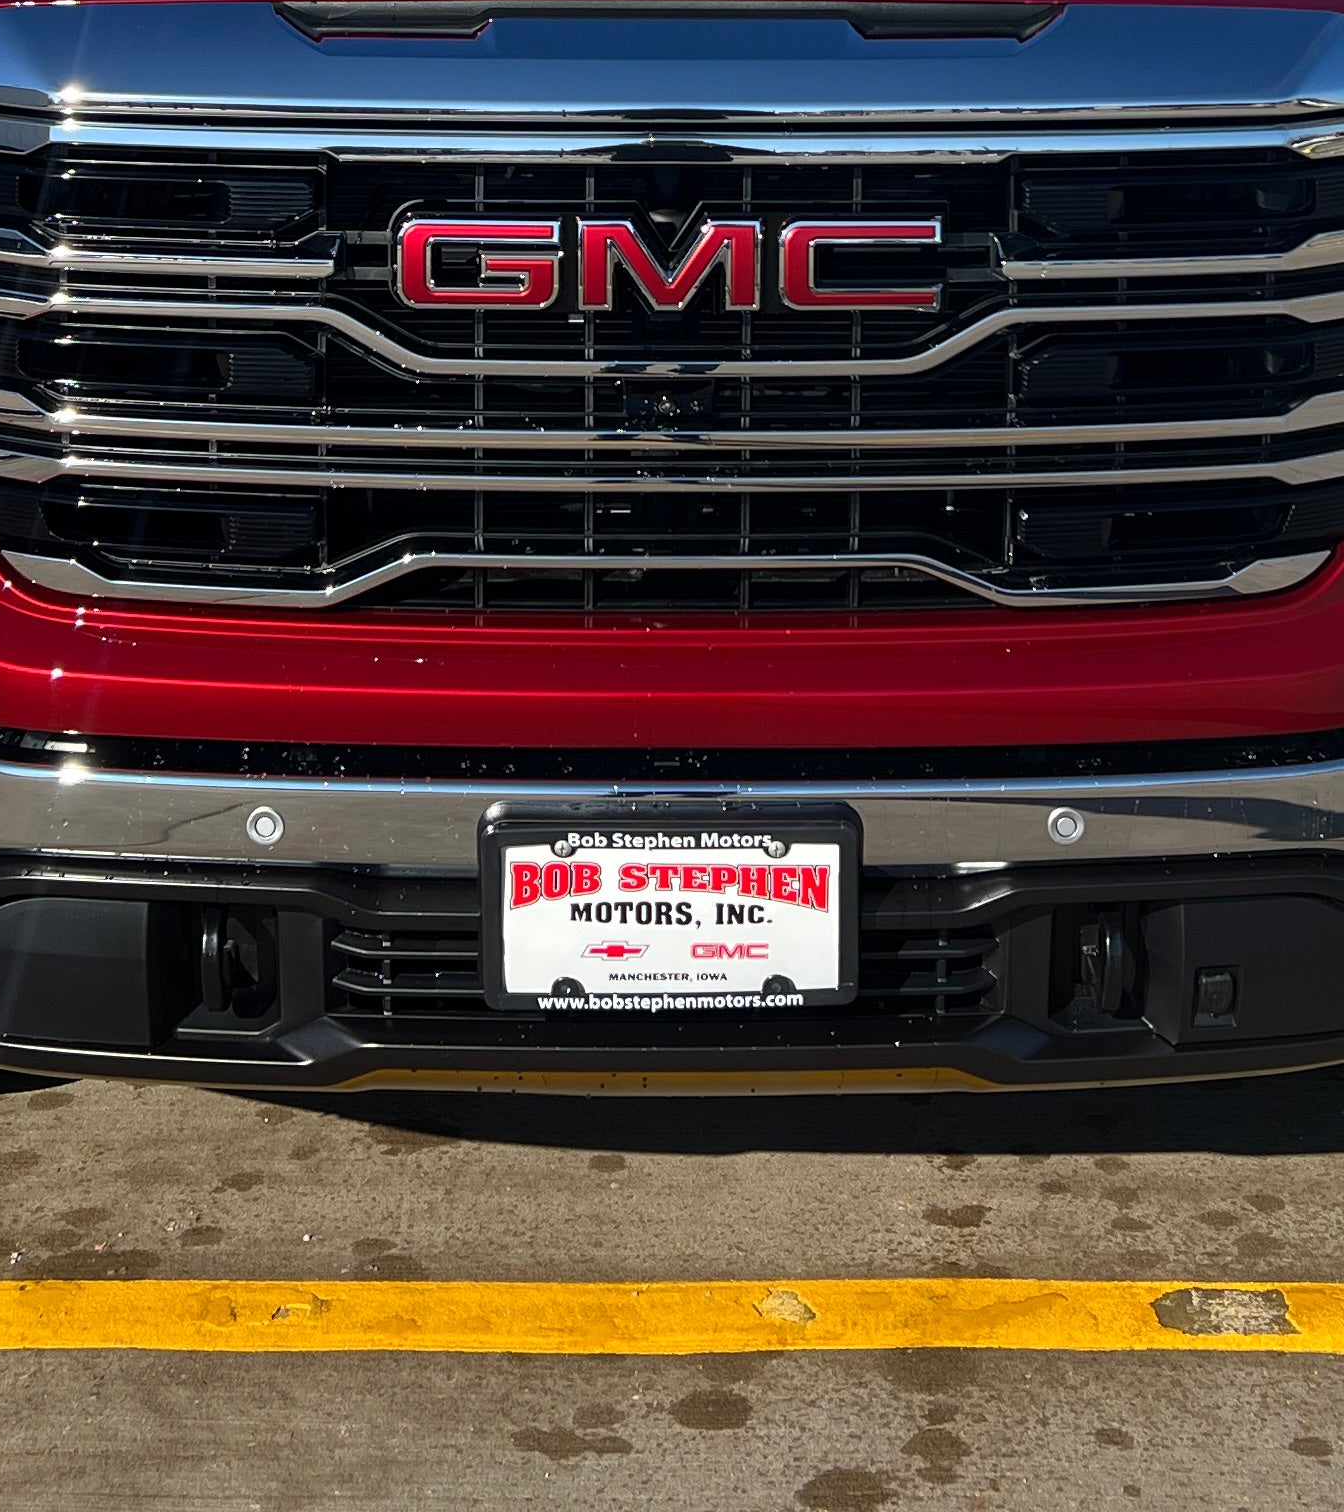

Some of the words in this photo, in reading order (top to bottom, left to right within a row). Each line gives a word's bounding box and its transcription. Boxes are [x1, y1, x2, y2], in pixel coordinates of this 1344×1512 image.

[394, 217, 944, 313] GMC
[567, 833, 608, 848] Bob
[612, 833, 698, 851] Stephen
[701, 832, 772, 848] Motors
[509, 860, 602, 910] BOB
[618, 862, 831, 913] STEPHEN
[570, 901, 701, 928] MOTORS,
[715, 902, 774, 925] INC.
[689, 942, 769, 960] GMC
[608, 972, 693, 982] MANCHESTER,
[696, 972, 728, 982] IOWA
[537, 994, 804, 1013] www.bobstephenmotors.com
